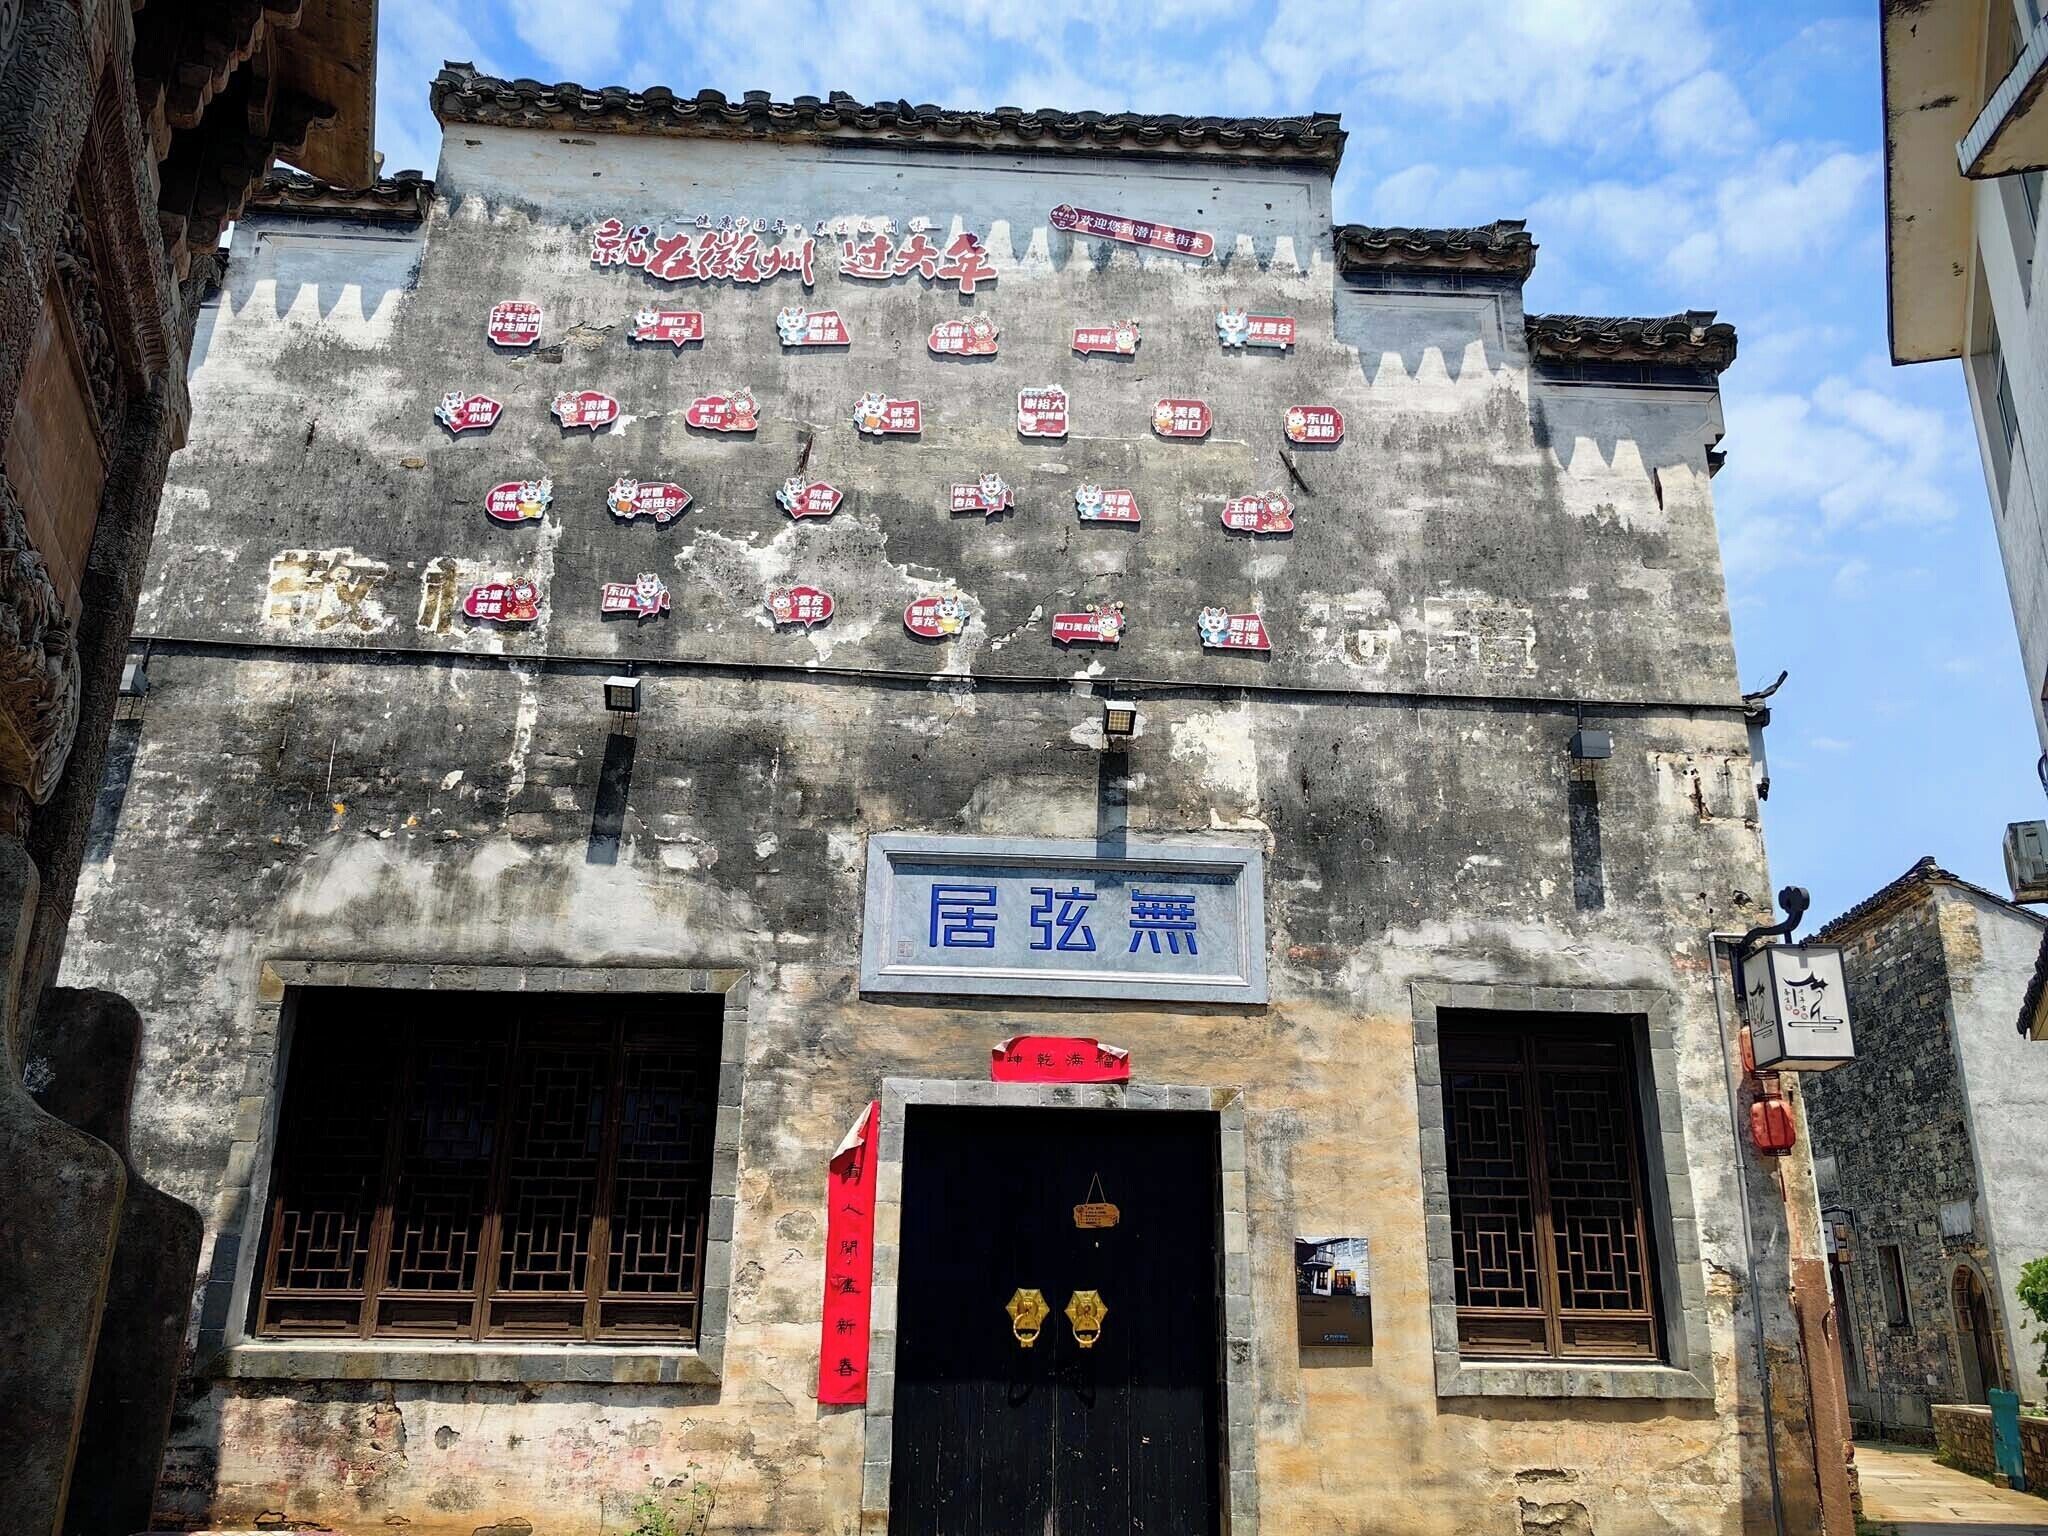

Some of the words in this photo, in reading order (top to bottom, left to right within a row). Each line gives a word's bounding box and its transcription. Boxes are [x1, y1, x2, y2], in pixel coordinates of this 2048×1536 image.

[1079, 213, 1204, 250] 欢迎您到潜口老街来
[591, 217, 817, 288] 就在徽州
[839, 232, 999, 294] 过大年
[493, 312, 539, 322] 千年古镇
[662, 317, 685, 326] 潜口
[492, 323, 539, 332] 养生潜口
[1024, 399, 1064, 409] 谢裕大
[890, 407, 914, 417] 研学
[1175, 407, 1201, 418] 美食
[469, 413, 492, 422] 小镇
[700, 414, 721, 423] 东山
[1307, 414, 1333, 424] 东山
[1174, 419, 1201, 430] 潜口
[492, 502, 516, 511] 徽州
[809, 500, 833, 510] 徽州
[1230, 502, 1257, 513] 玉林
[1104, 507, 1130, 517] 牛肉
[608, 587, 631, 596] 东山
[1231, 619, 1259, 631] 蜀源
[1230, 633, 1259, 645] 花海
